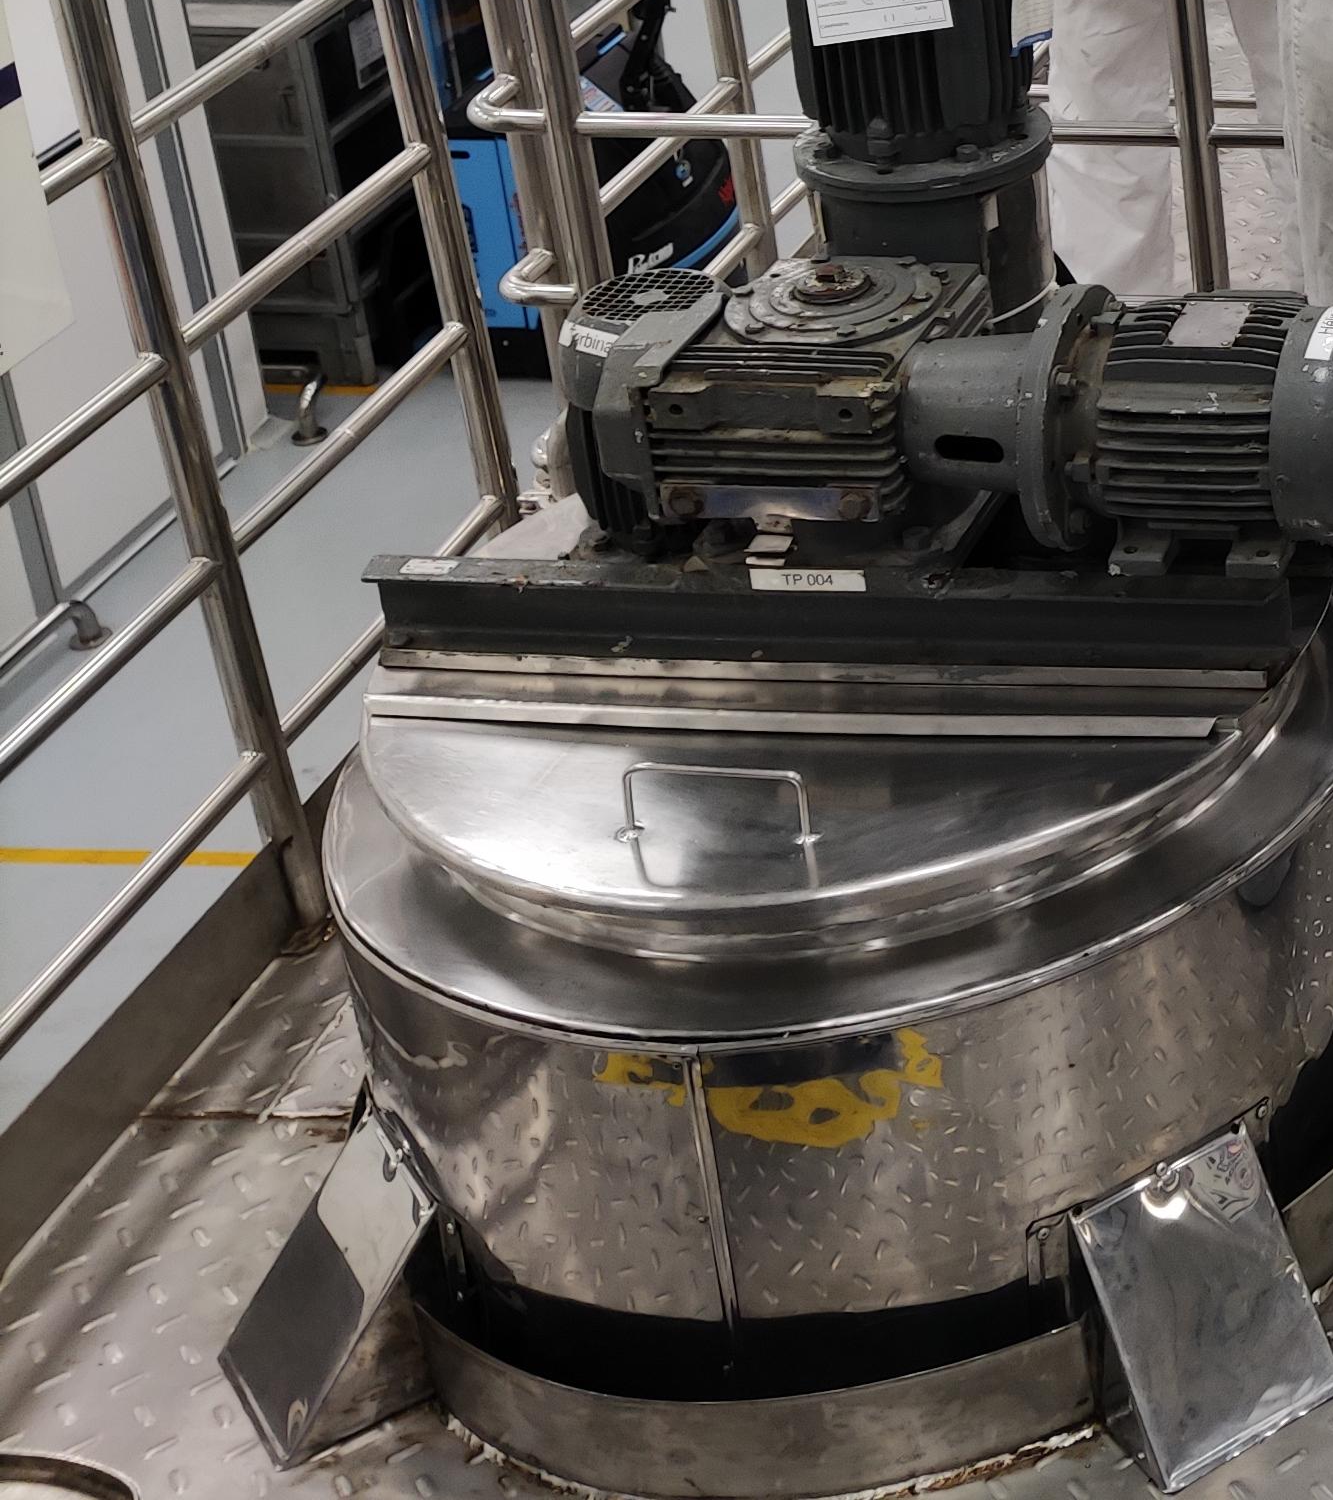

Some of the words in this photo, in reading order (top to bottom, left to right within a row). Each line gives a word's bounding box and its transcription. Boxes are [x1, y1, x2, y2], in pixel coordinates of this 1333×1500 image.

[571, 324, 613, 353] rbina
[781, 573, 803, 586] TP
[806, 573, 833, 586] 004
